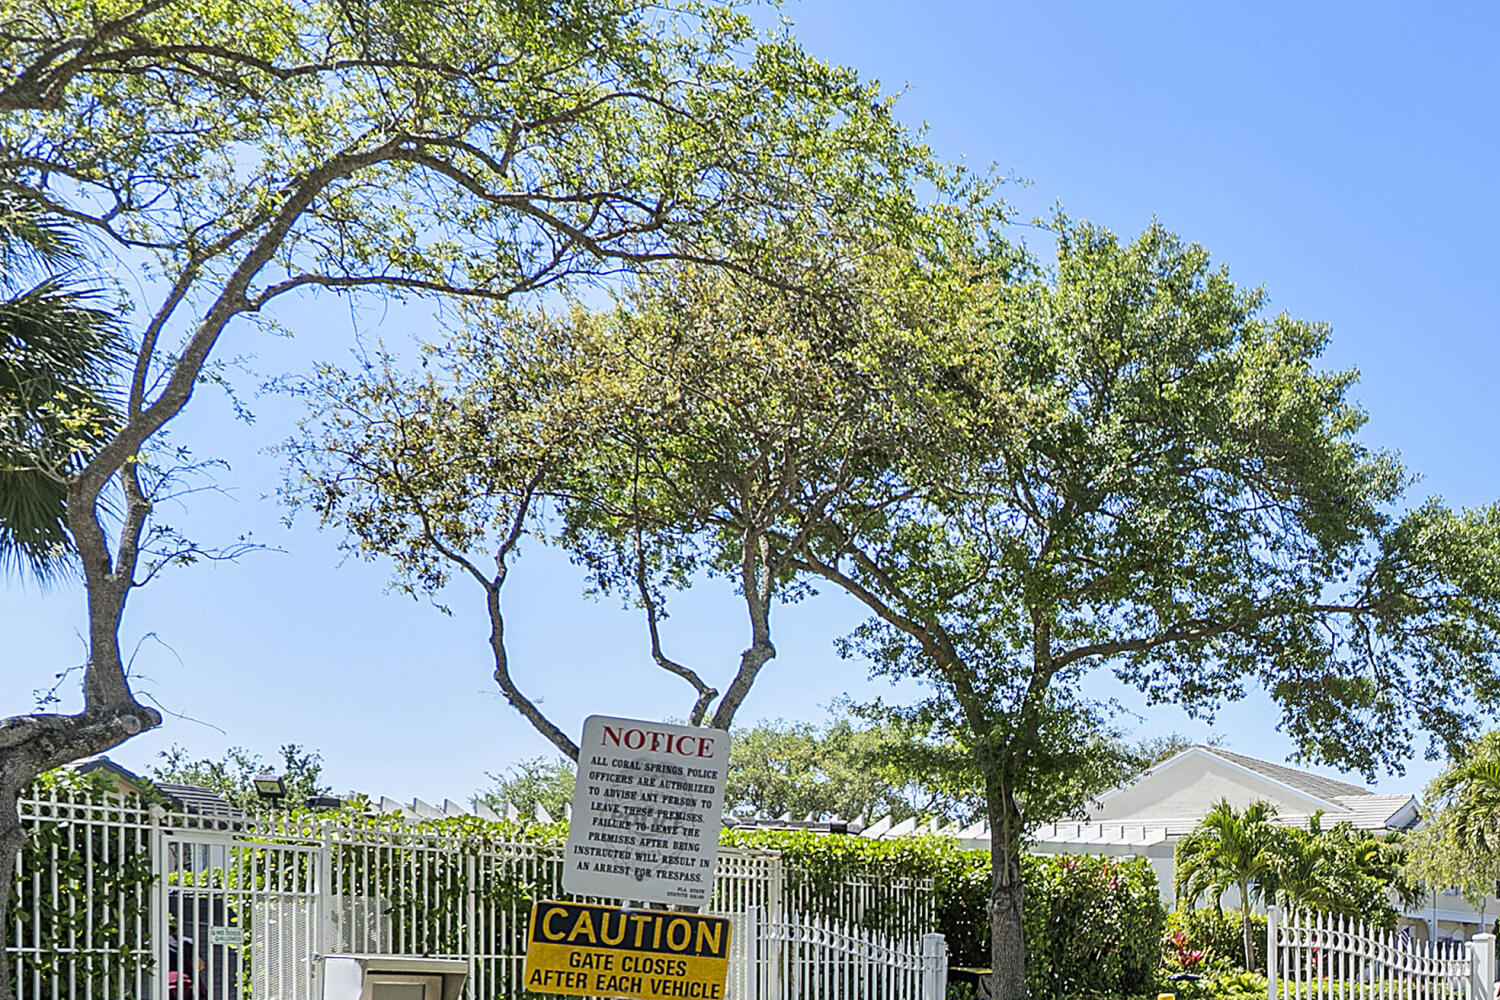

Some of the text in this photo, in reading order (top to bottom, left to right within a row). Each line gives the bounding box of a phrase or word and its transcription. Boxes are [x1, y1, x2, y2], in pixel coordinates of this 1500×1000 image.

[600, 726, 715, 758] NOTICE
[591, 756, 718, 780] ALL CORAL SPRINGS POLICE
[589, 771, 715, 794] OFFICERS ARE AUTHORIZED
[589, 786, 712, 809] TO ADVISE ANY PERSON TO
[590, 801, 620, 814] LEAVE
[623, 805, 653, 818] THESE
[592, 816, 700, 838] FAILURE TO LEAVE THE
[588, 831, 700, 852] PREMISES AFTER BEING
[573, 845, 710, 868] INSTRUCTED WILL RESULT IN
[576, 861, 589, 871] AN
[593, 863, 631, 876] ARREST
[634, 867, 652, 878] FOR
[542, 907, 723, 954] CAUTION
[569, 951, 687, 977] GATE CLOSES
[529, 968, 720, 1000] AFTER EACH VEHICLE
